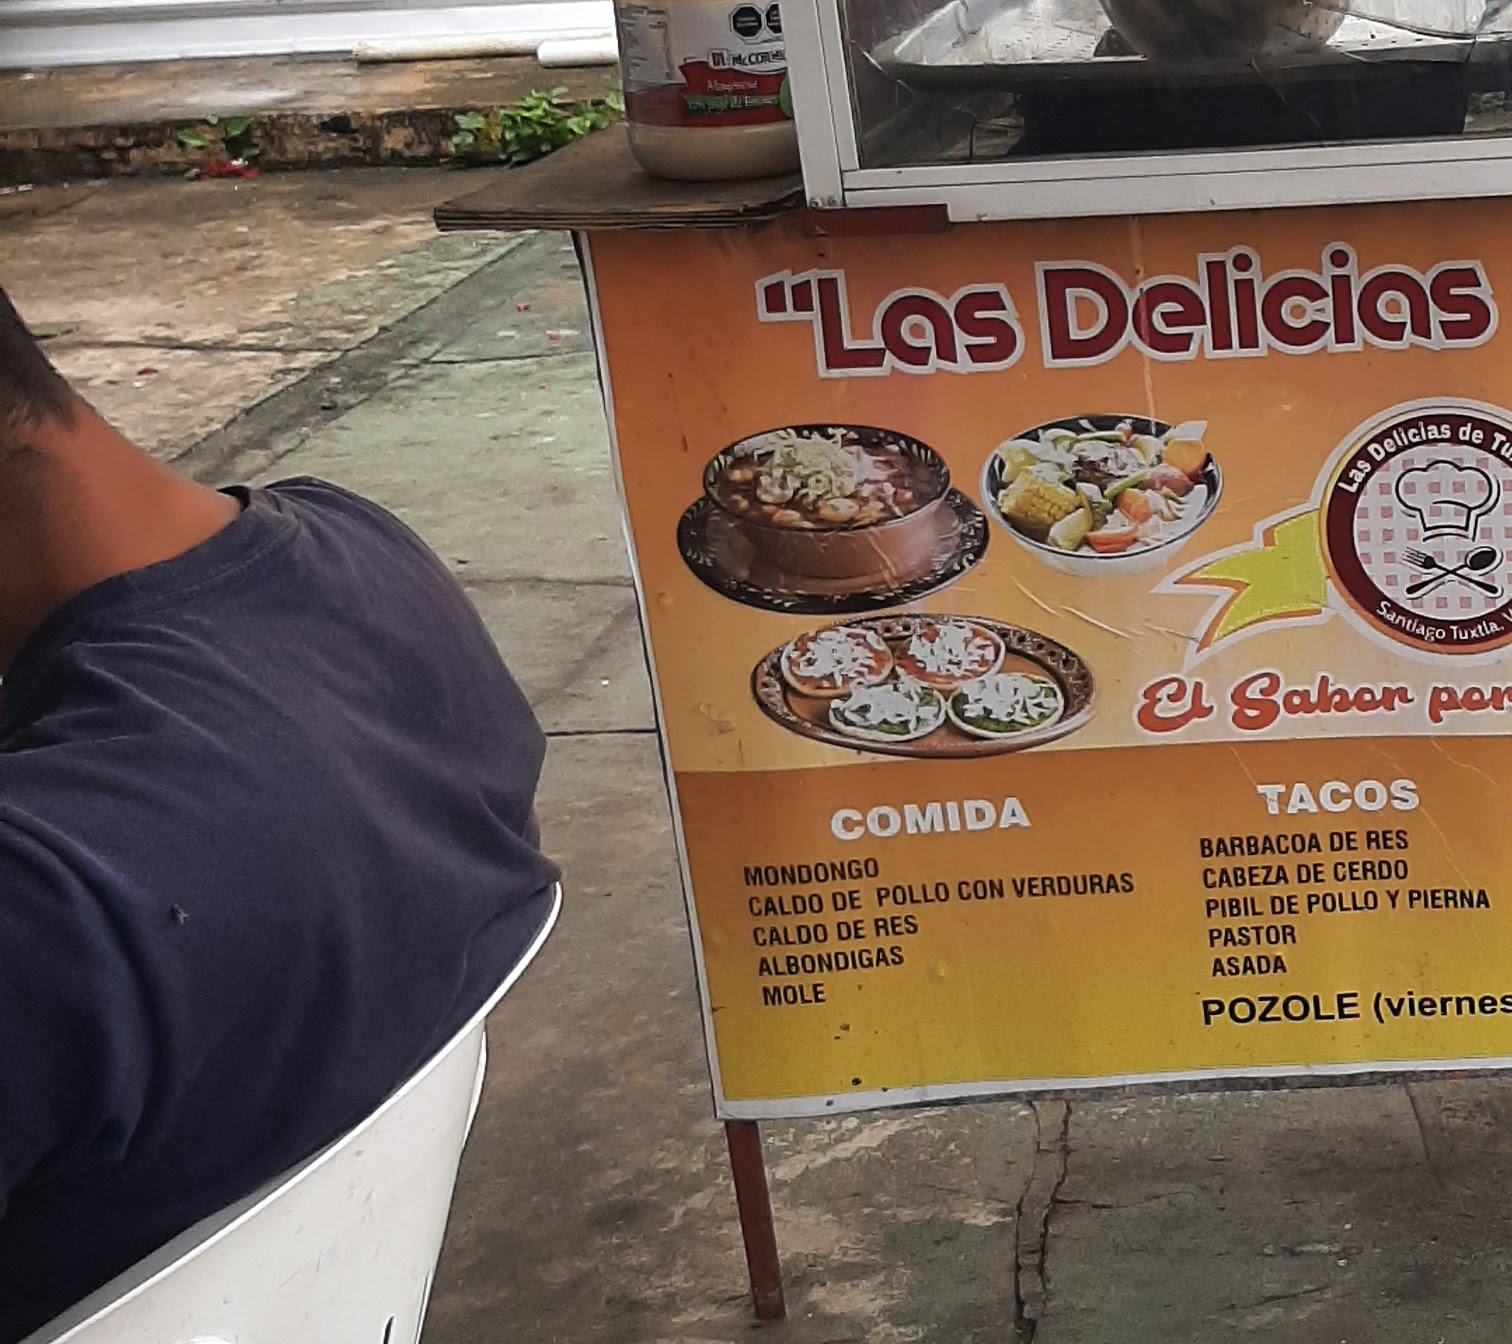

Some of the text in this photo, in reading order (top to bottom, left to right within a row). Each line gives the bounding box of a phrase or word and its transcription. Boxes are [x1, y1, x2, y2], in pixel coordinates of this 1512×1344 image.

[760, 270, 1020, 373] "Las
[1038, 246, 1494, 362] Delicias
[1338, 462, 1372, 494] Las
[1366, 422, 1452, 460] Delicias
[1459, 422, 1484, 444] de
[1376, 600, 1447, 642] Santiago
[1450, 619, 1505, 641] Tuxtla,
[1136, 676, 1212, 733] El
[1231, 672, 1414, 731] Sabor
[1256, 779, 1421, 816] TACOS
[831, 797, 1032, 841] COMIDA
[1200, 829, 1410, 858] BARBACOA DE RES
[744, 858, 880, 887] MONDONGO
[1203, 859, 1409, 889] CABEZA DE CERDO
[748, 873, 1135, 917] CALDO DE POLLO CON VERDURAS
[1205, 888, 1491, 919] PIBIL DE POLLO Y PIERNA
[753, 915, 919, 947] CALDO DE RES
[1209, 925, 1297, 948] PASTOR
[758, 946, 905, 977] ALBONDIGAS
[1211, 955, 1288, 977] ASADA
[763, 984, 827, 1007] MOLE
[1202, 992, 1360, 1025] POZOLE
